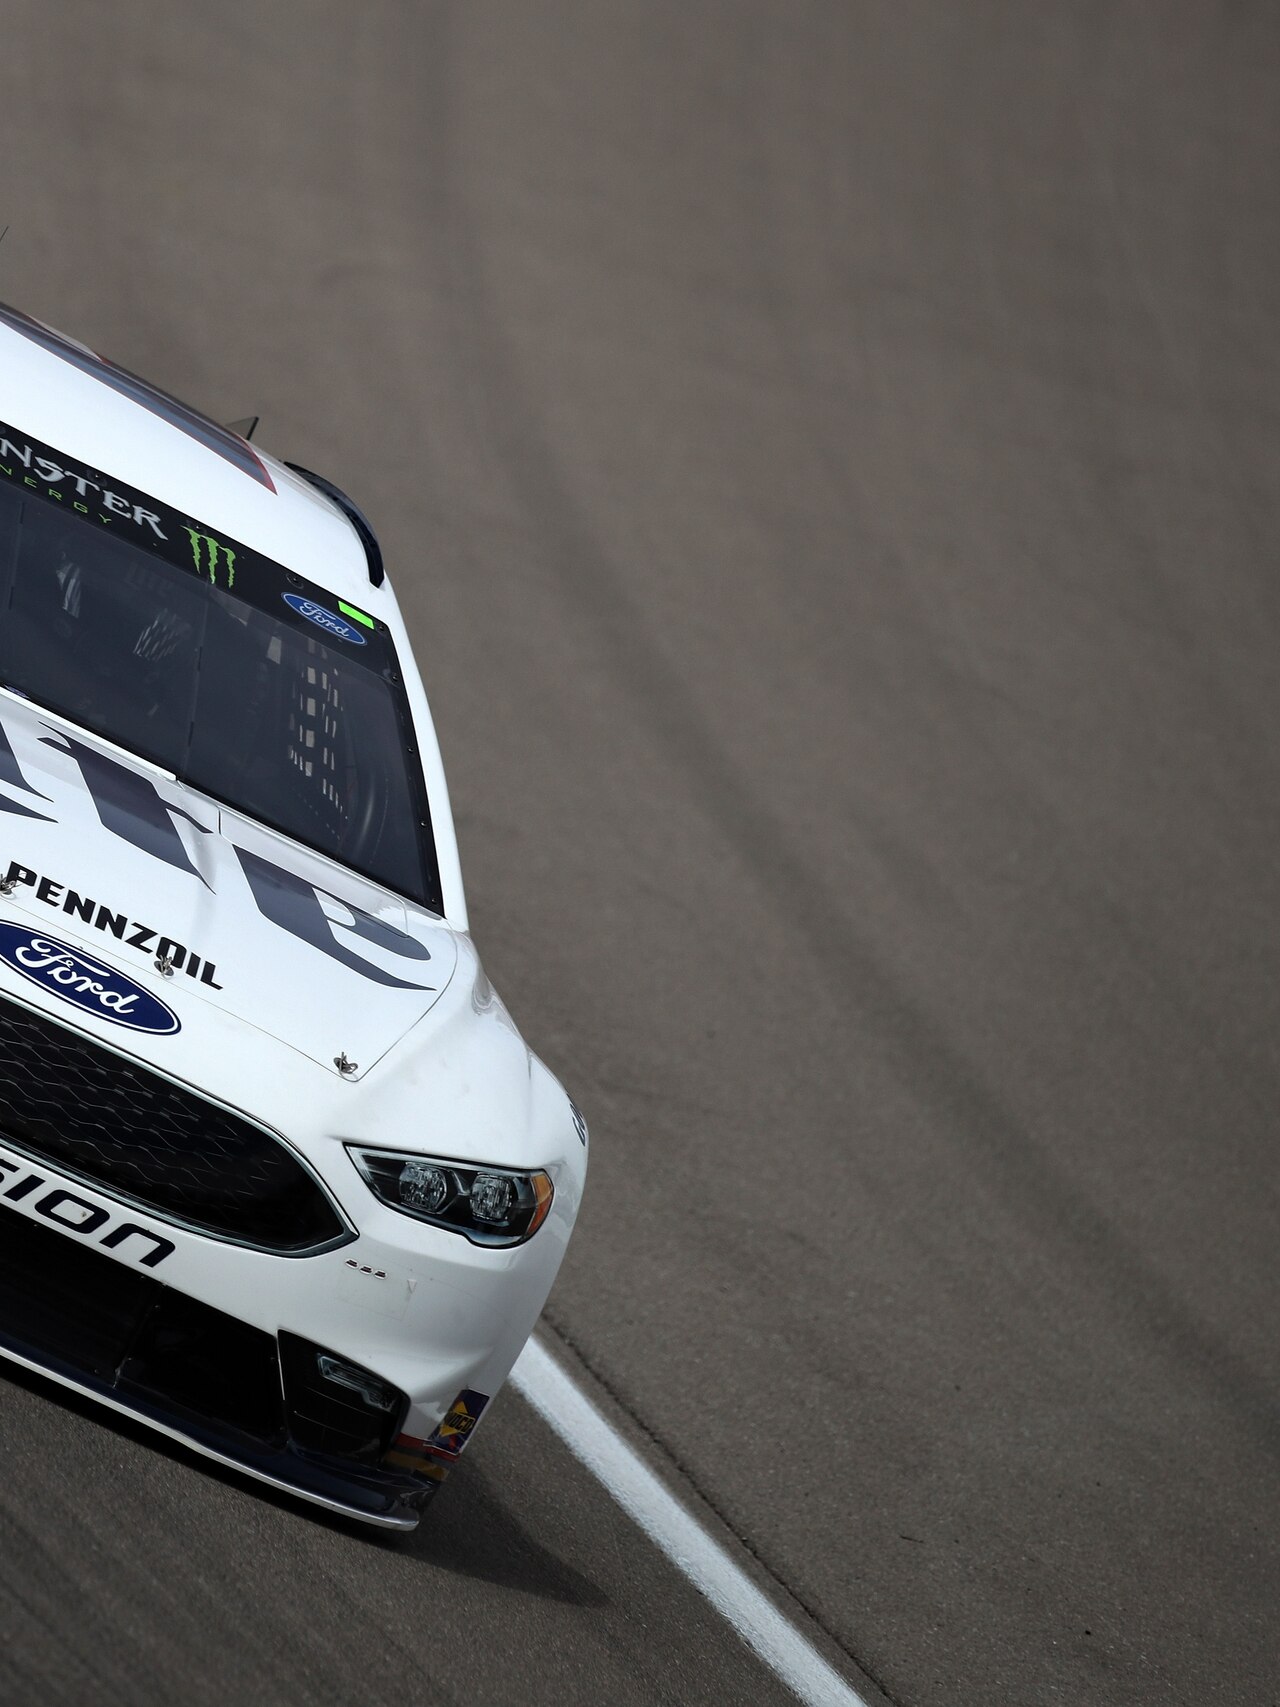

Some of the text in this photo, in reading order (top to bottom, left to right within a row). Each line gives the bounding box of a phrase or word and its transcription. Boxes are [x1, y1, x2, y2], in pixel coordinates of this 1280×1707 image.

[299, 601, 349, 638] Ford
[5, 861, 224, 991] PENNZOIL
[15, 938, 140, 1014] Ford
